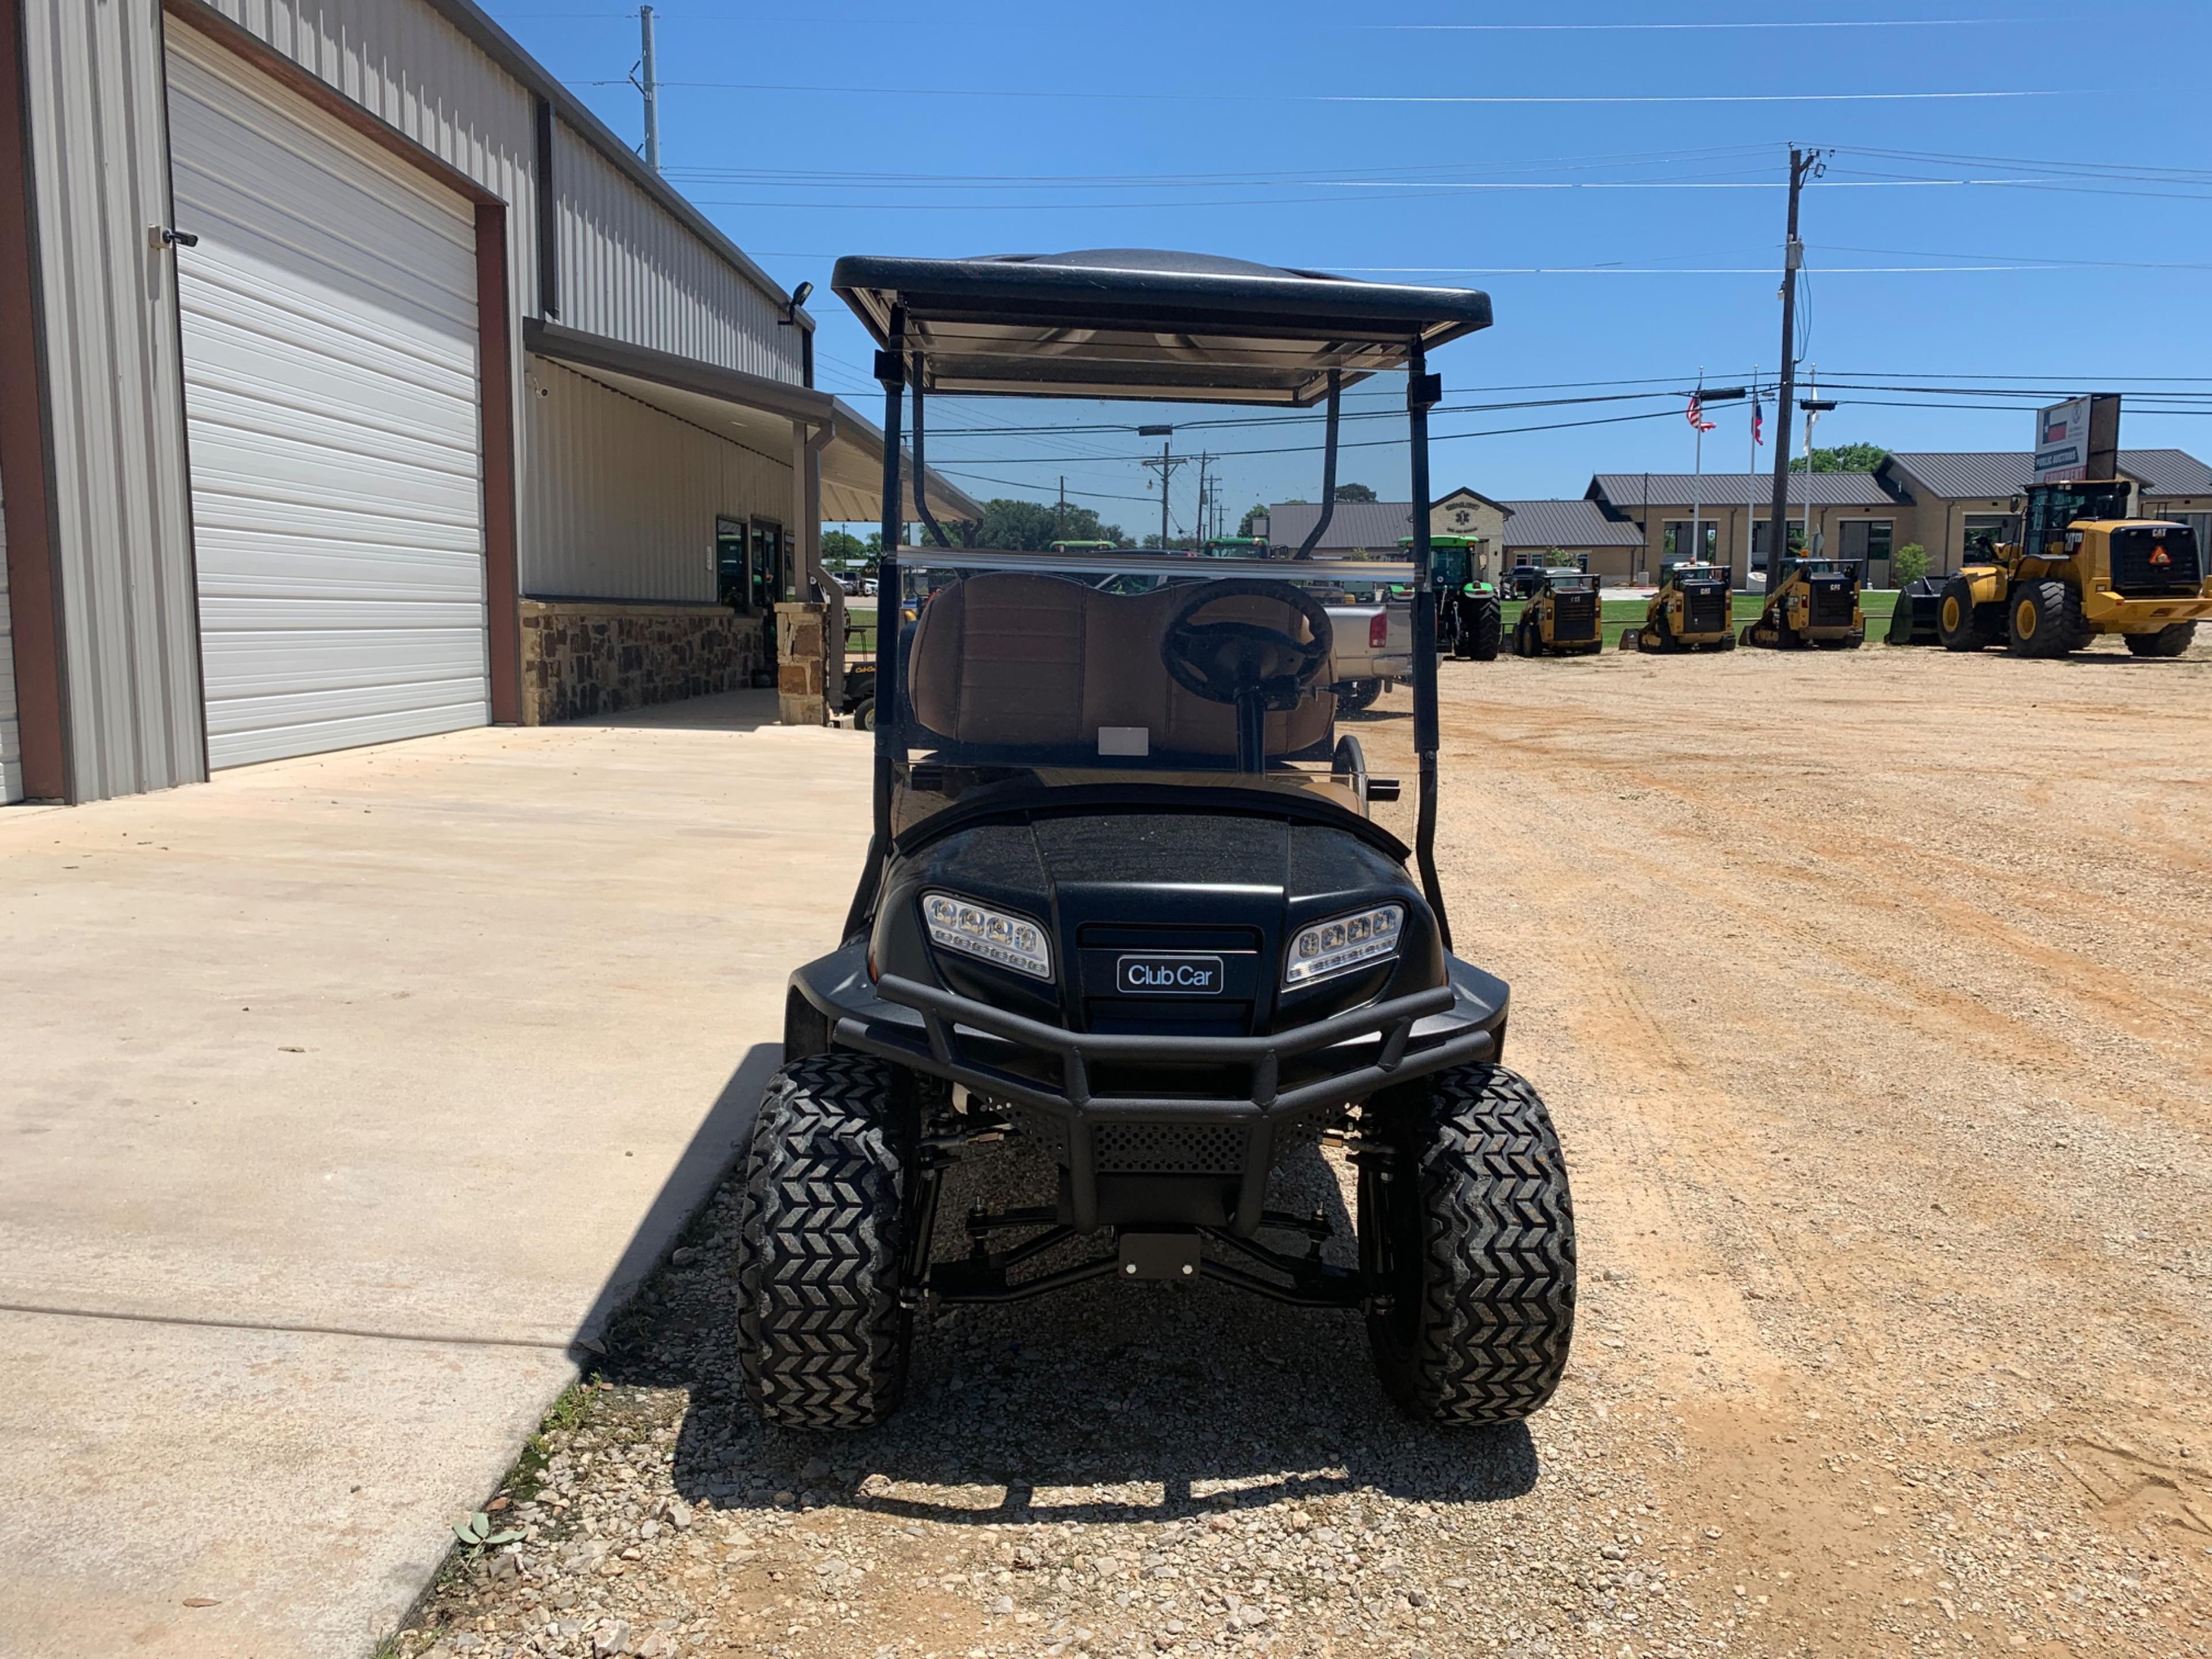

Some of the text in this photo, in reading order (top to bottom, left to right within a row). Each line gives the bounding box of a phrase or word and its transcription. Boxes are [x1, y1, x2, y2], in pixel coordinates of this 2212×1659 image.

[2036, 456, 2052, 468] PUBLIC
[2152, 528, 2167, 537] CAT
[1128, 964, 1213, 986] Club Car
